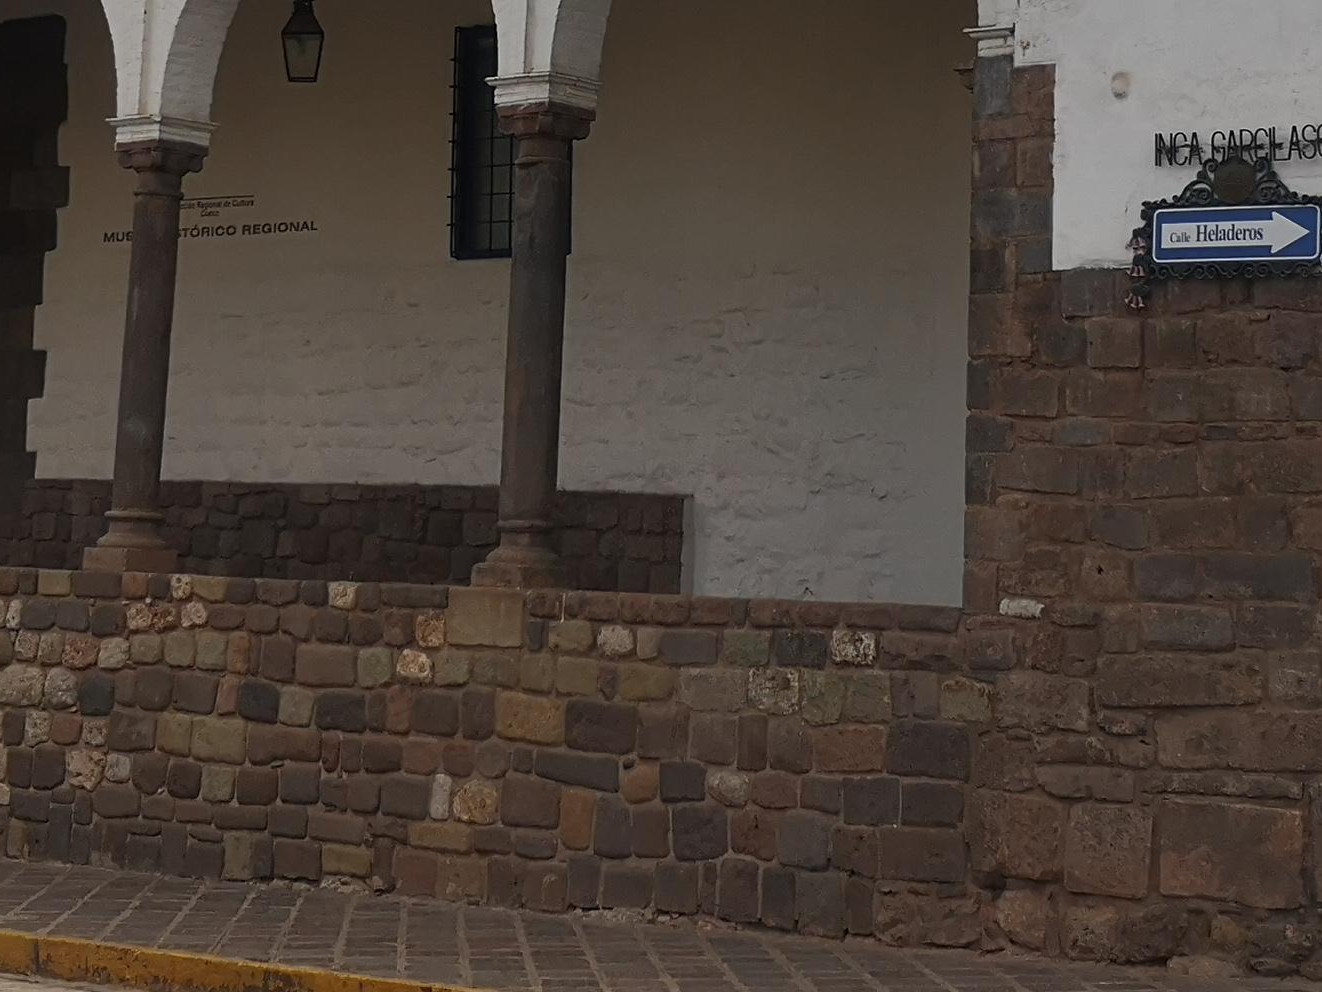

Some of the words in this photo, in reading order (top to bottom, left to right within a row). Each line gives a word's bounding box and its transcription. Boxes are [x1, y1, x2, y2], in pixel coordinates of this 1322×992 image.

[1154, 132, 1203, 167] INCA
[102, 230, 134, 244] MUS
[241, 220, 319, 237] REGIONAL
[1169, 231, 1191, 244] Calle
[1195, 224, 1264, 243] Heladeros
